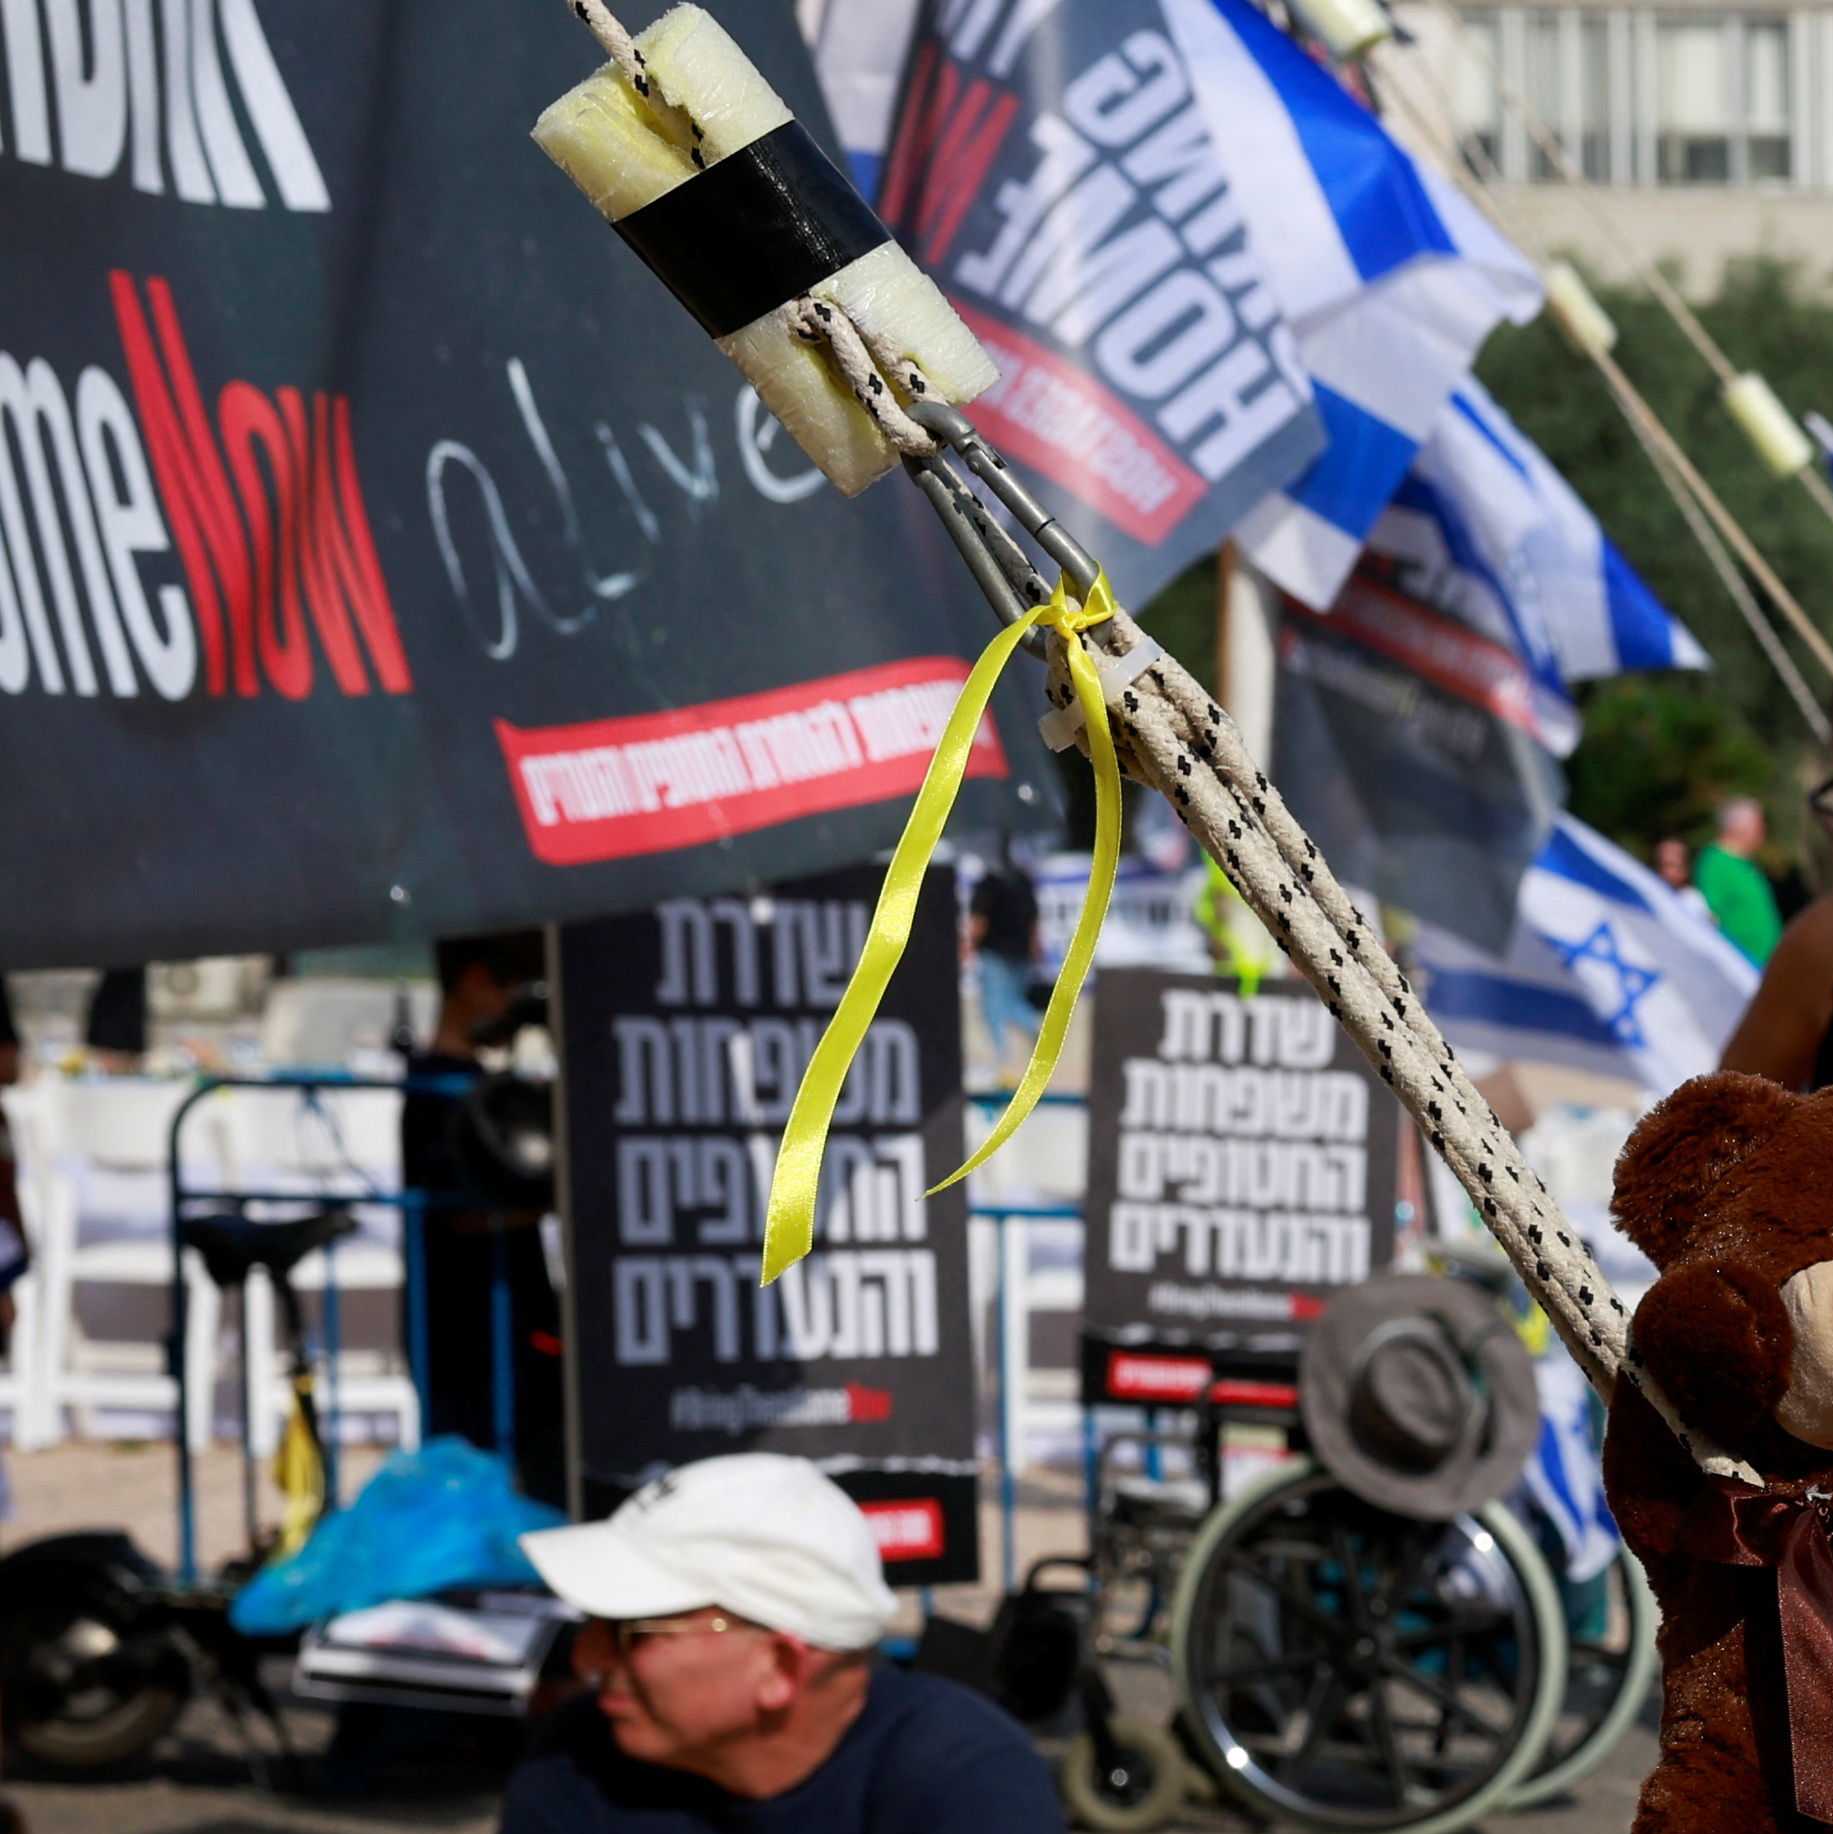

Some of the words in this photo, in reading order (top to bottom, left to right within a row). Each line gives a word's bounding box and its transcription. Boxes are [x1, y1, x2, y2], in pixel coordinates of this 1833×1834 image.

[1160, 991, 1338, 1068] שדרת
[611, 1018, 923, 1126] מפחות
[1121, 1058, 1370, 1143] משפחות
[615, 1133, 928, 1246] החופים
[1116, 1132, 1368, 1214] החטופים
[1108, 1202, 1373, 1286] והנעדרים
